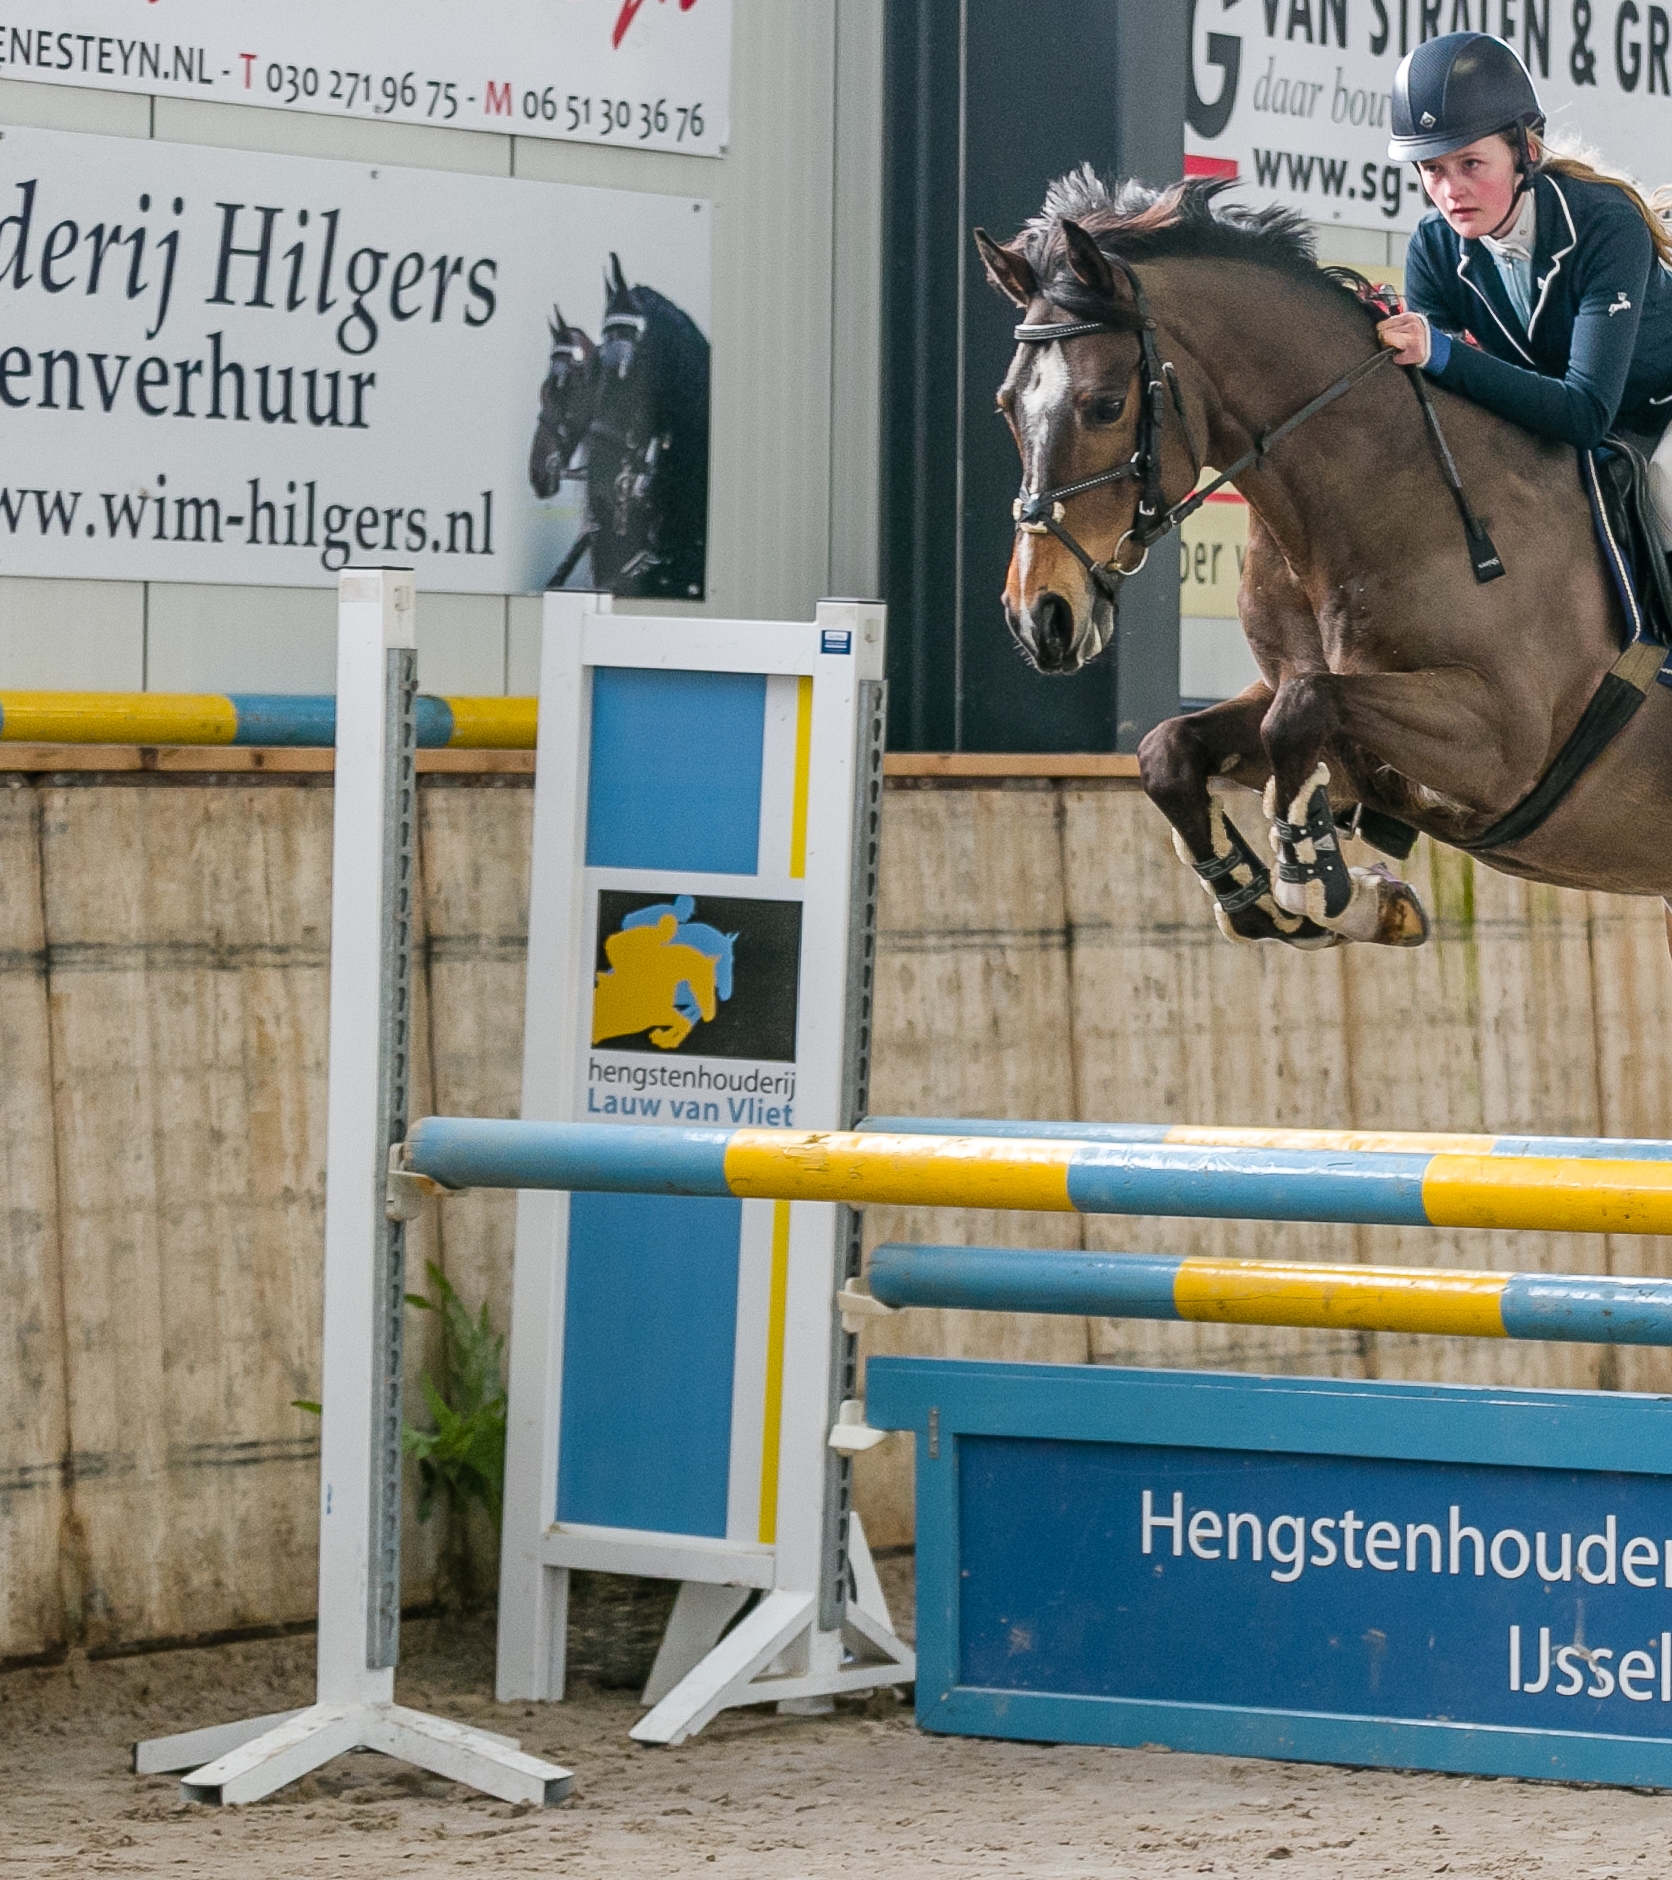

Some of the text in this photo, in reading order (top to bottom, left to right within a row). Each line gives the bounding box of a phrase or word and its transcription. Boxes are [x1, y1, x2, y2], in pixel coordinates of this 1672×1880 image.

[1263, 0, 1348, 50] VAN
[1570, 0, 1597, 87] &
[239, 53, 257, 89] T
[266, 63, 319, 103] 030
[329, 70, 371, 109] 271
[382, 72, 416, 114] 96
[426, 81, 458, 119] 75
[484, 81, 512, 116] M
[523, 87, 557, 120] 06
[567, 96, 591, 131] 51
[600, 99, 630, 136] 30
[639, 99, 669, 140] 36
[676, 103, 704, 142] 76
[1254, 56, 1392, 128] daar bou
[205, 200, 498, 356] Hilgers
[0, 332, 377, 430] enverhuur
[587, 1087, 793, 1128] Lauw van Vliet
[588, 1057, 796, 1102] hengstenhouderij
